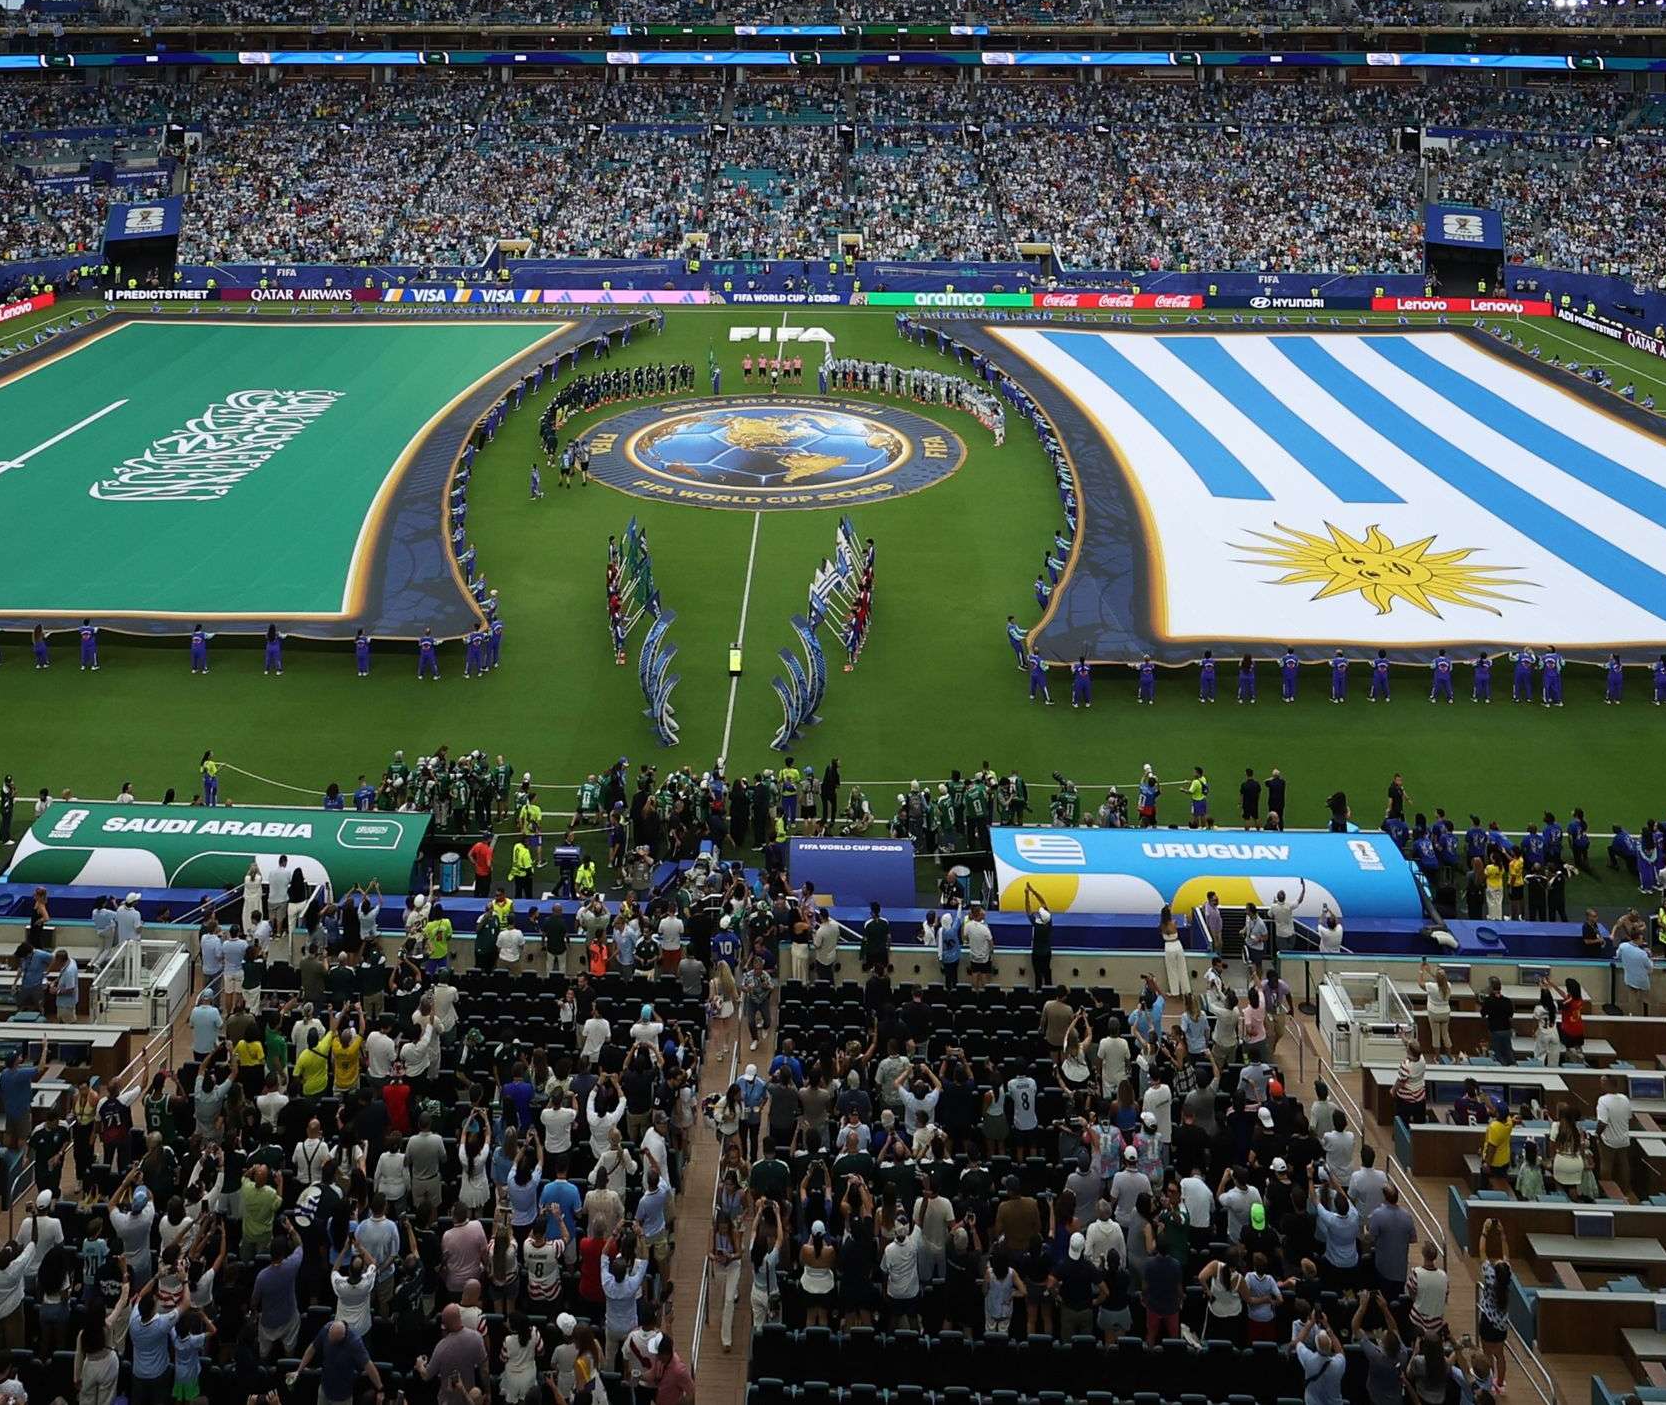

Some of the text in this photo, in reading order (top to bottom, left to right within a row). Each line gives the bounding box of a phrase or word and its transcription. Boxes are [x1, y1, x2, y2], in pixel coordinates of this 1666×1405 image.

[276, 268, 297, 277] FIFA
[1258, 274, 1280, 284] FIFA
[116, 289, 209, 300] PREDICTSTREET
[251, 289, 352, 301] QATAR AIRWAYS
[410, 289, 446, 302] VISA
[479, 289, 516, 302] VISA
[733, 293, 753, 303] FIFA
[753, 293, 786, 303] WORLD
[789, 293, 805, 303] CUP
[914, 292, 985, 306] aramco
[1042, 294, 1078, 307] Coca-Cola
[1098, 294, 1135, 307] Coca-Cola
[1154, 295, 1192, 308] Coca-Cola
[1273, 297, 1325, 308] HYUNDAI
[1397, 298, 1447, 311] Lenovo
[1470, 299, 1524, 313] Lenovo
[1558, 309, 1623, 339] ADI PREDICTSTREET
[729, 327, 836, 343] FIFA
[1628, 333, 1657, 354] QATAR
[632, 480, 895, 505] FIFA WORLD CUP 2026
[101, 817, 313, 839] SAUDI ARABIA
[1142, 842, 1290, 860] URUGUAY
[719, 941, 733, 955] 10
[1021, 1092, 1029, 1110] 8
